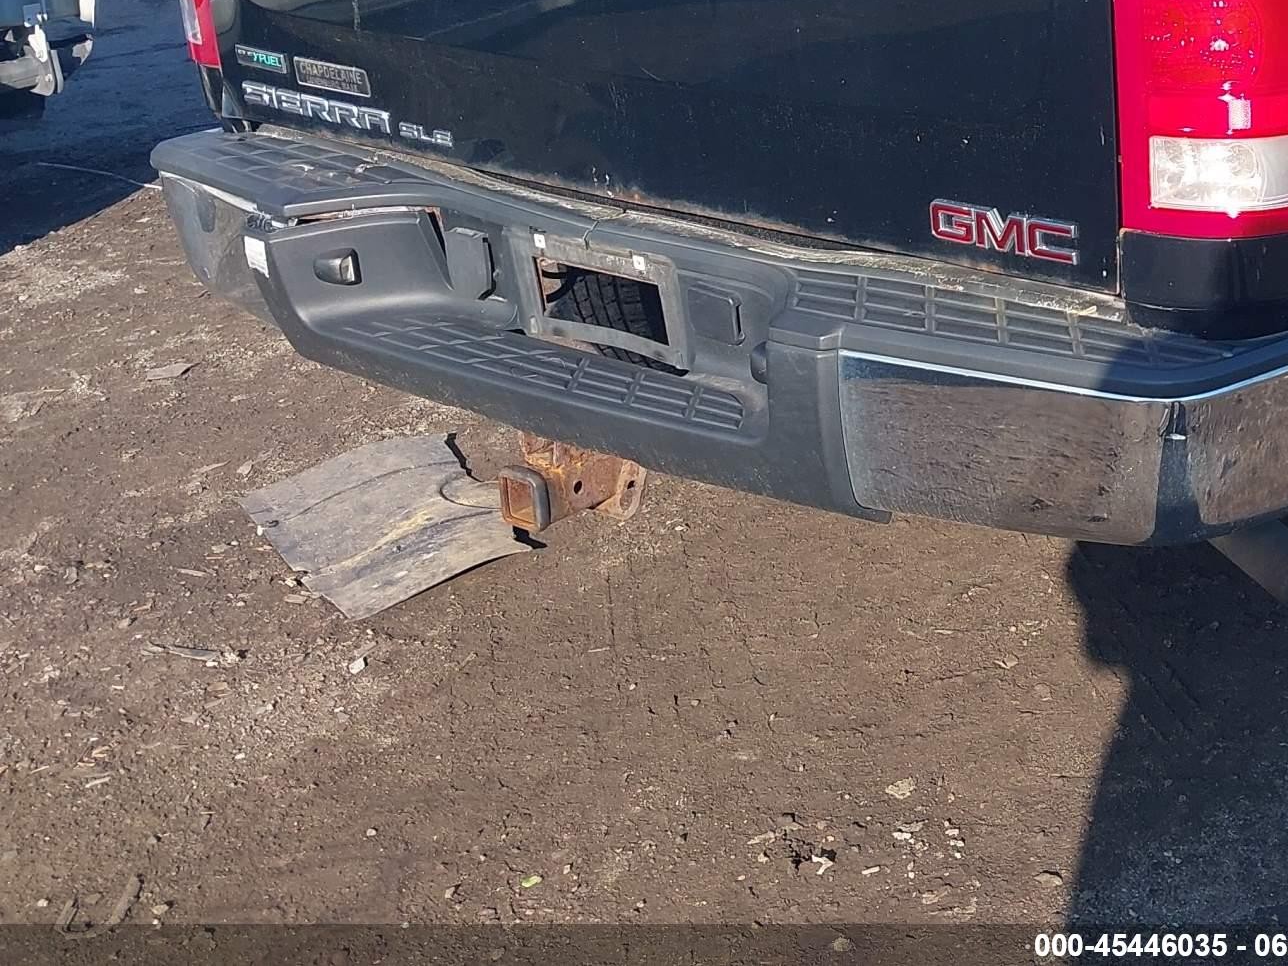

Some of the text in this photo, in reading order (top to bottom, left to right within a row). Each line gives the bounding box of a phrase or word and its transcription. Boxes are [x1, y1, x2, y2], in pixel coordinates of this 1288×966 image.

[300, 62, 363, 84] CHAPDELAINE
[242, 81, 453, 147] SIERRA SLE
[930, 198, 1079, 266] GMC
